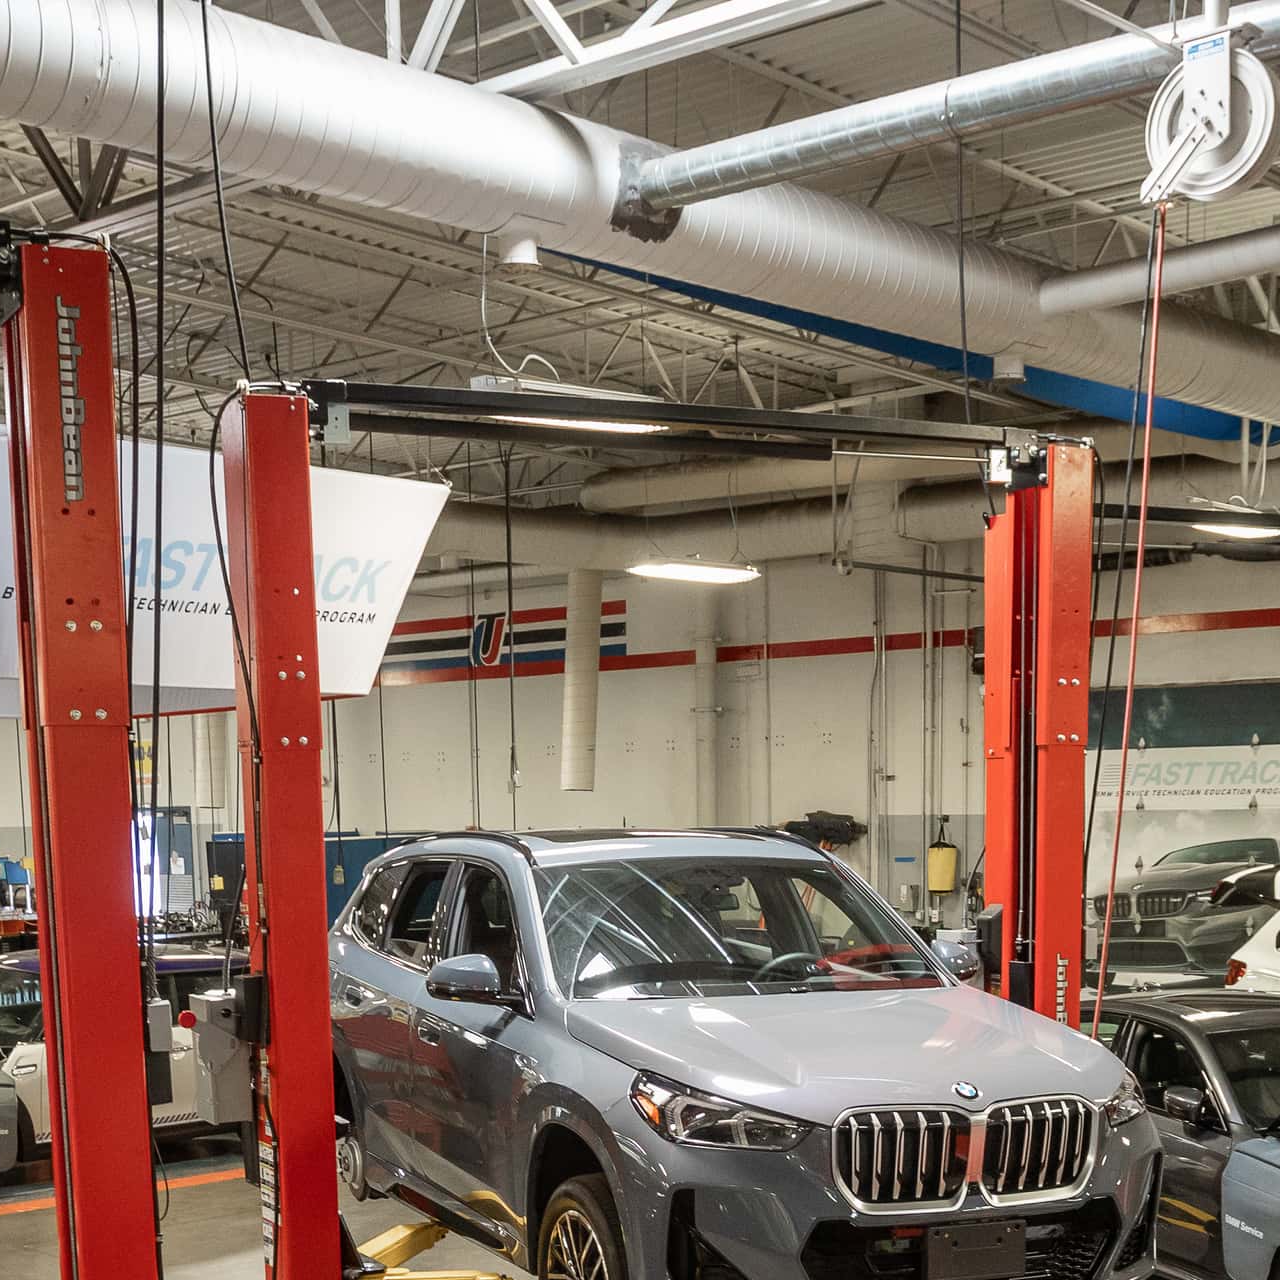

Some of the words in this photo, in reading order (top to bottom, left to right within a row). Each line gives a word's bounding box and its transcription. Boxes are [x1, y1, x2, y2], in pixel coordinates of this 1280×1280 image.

[56, 295, 87, 502] JohnBean
[123, 534, 225, 593] AST
[1130, 762, 1204, 786] FAST
[1204, 788, 1252, 796] EDUCATION
[1056, 952, 1070, 1025] JohnB
[1240, 1221, 1264, 1240] Service
